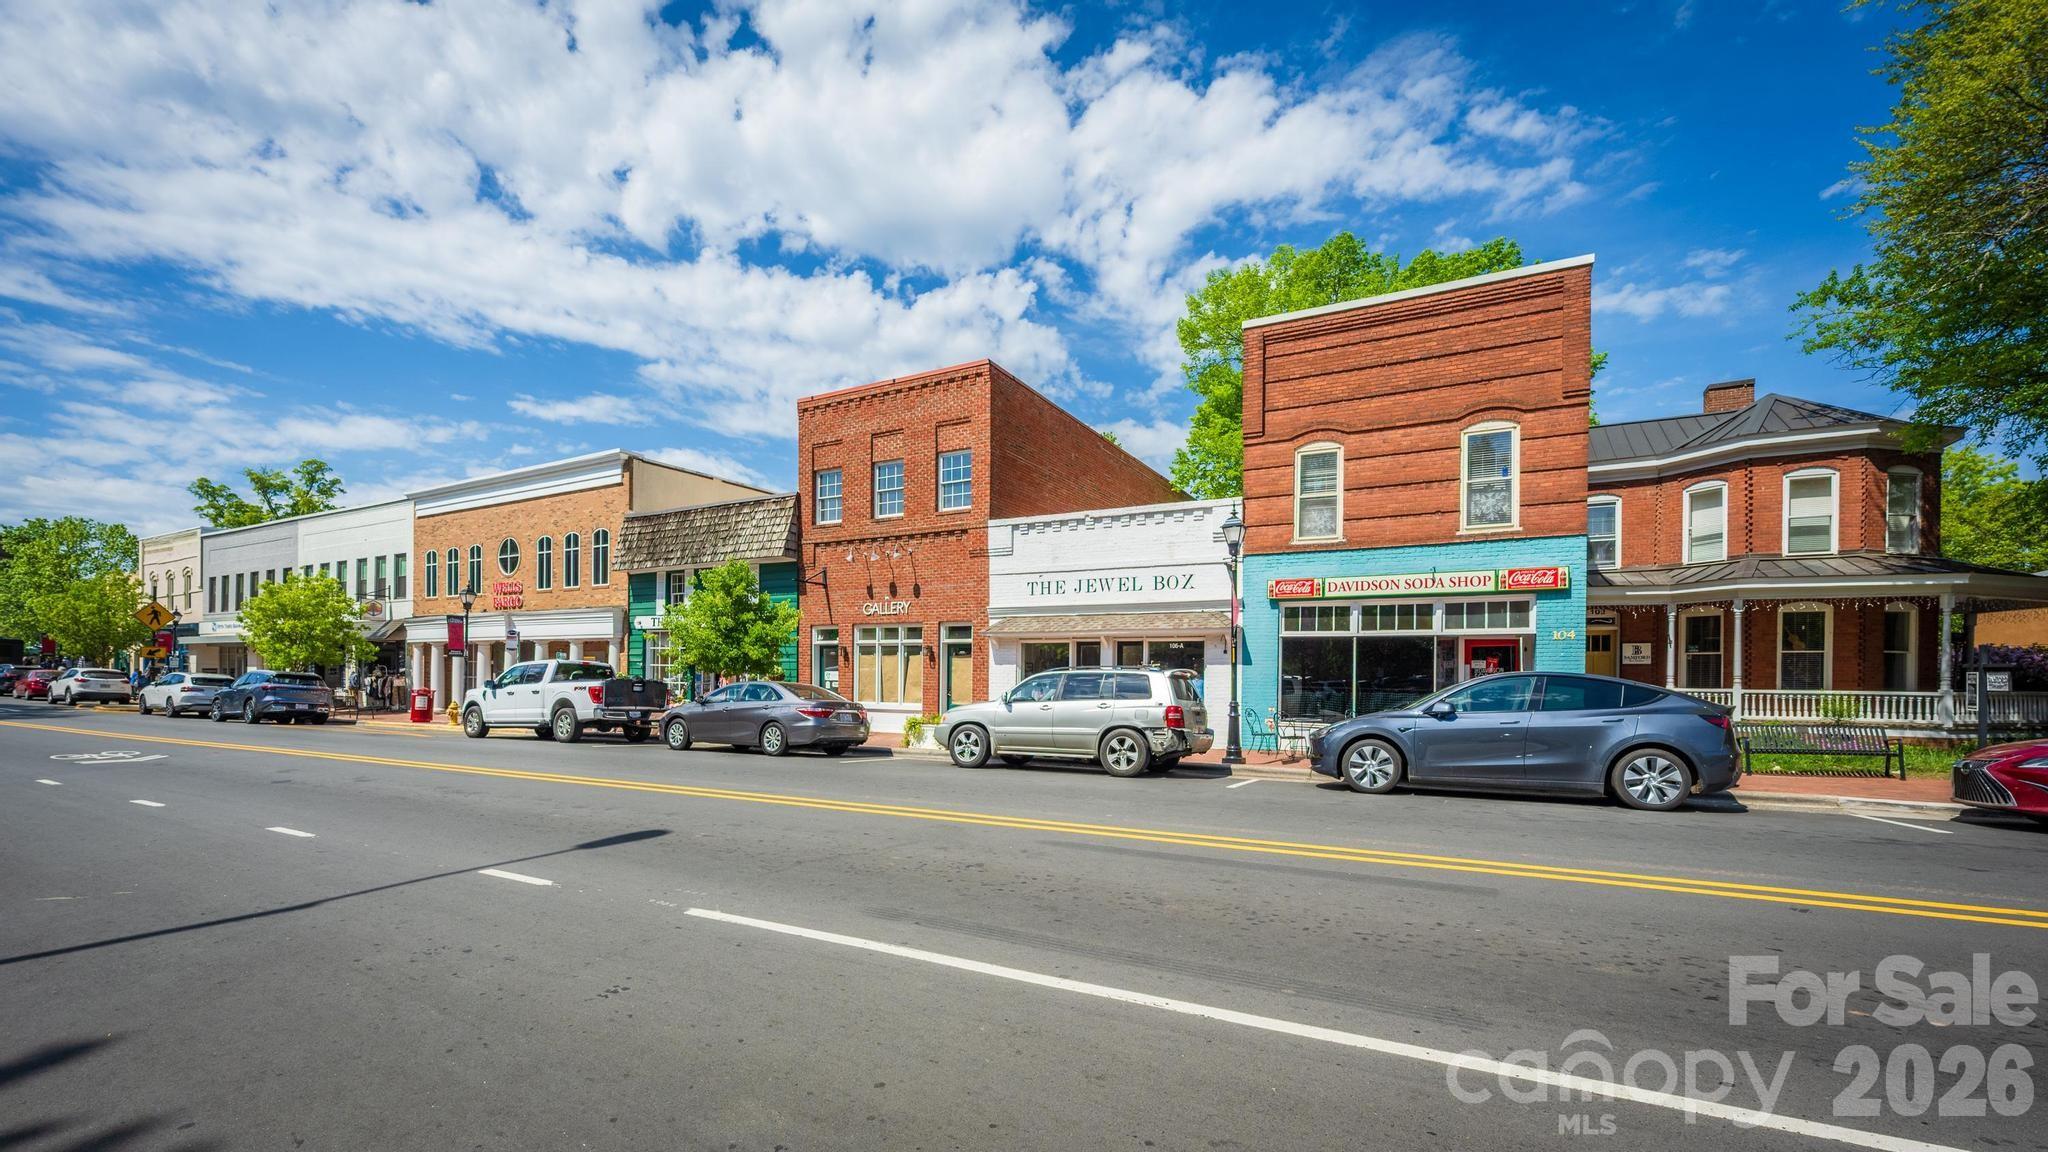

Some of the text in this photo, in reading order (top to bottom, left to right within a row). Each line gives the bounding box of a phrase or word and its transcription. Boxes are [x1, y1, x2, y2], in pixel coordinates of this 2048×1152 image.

[1327, 575, 1492, 593] DAVIDSON SODA SHOP
[1508, 570, 1557, 585] Coca-Cola
[493, 582, 523, 594] WELLS
[1027, 574, 1195, 596] THE JEWEL BOX
[1275, 580, 1313, 594] Coca-Cola
[493, 597, 522, 609] FARGO
[862, 601, 911, 616] GALLERY
[1552, 630, 1575, 640] 104
